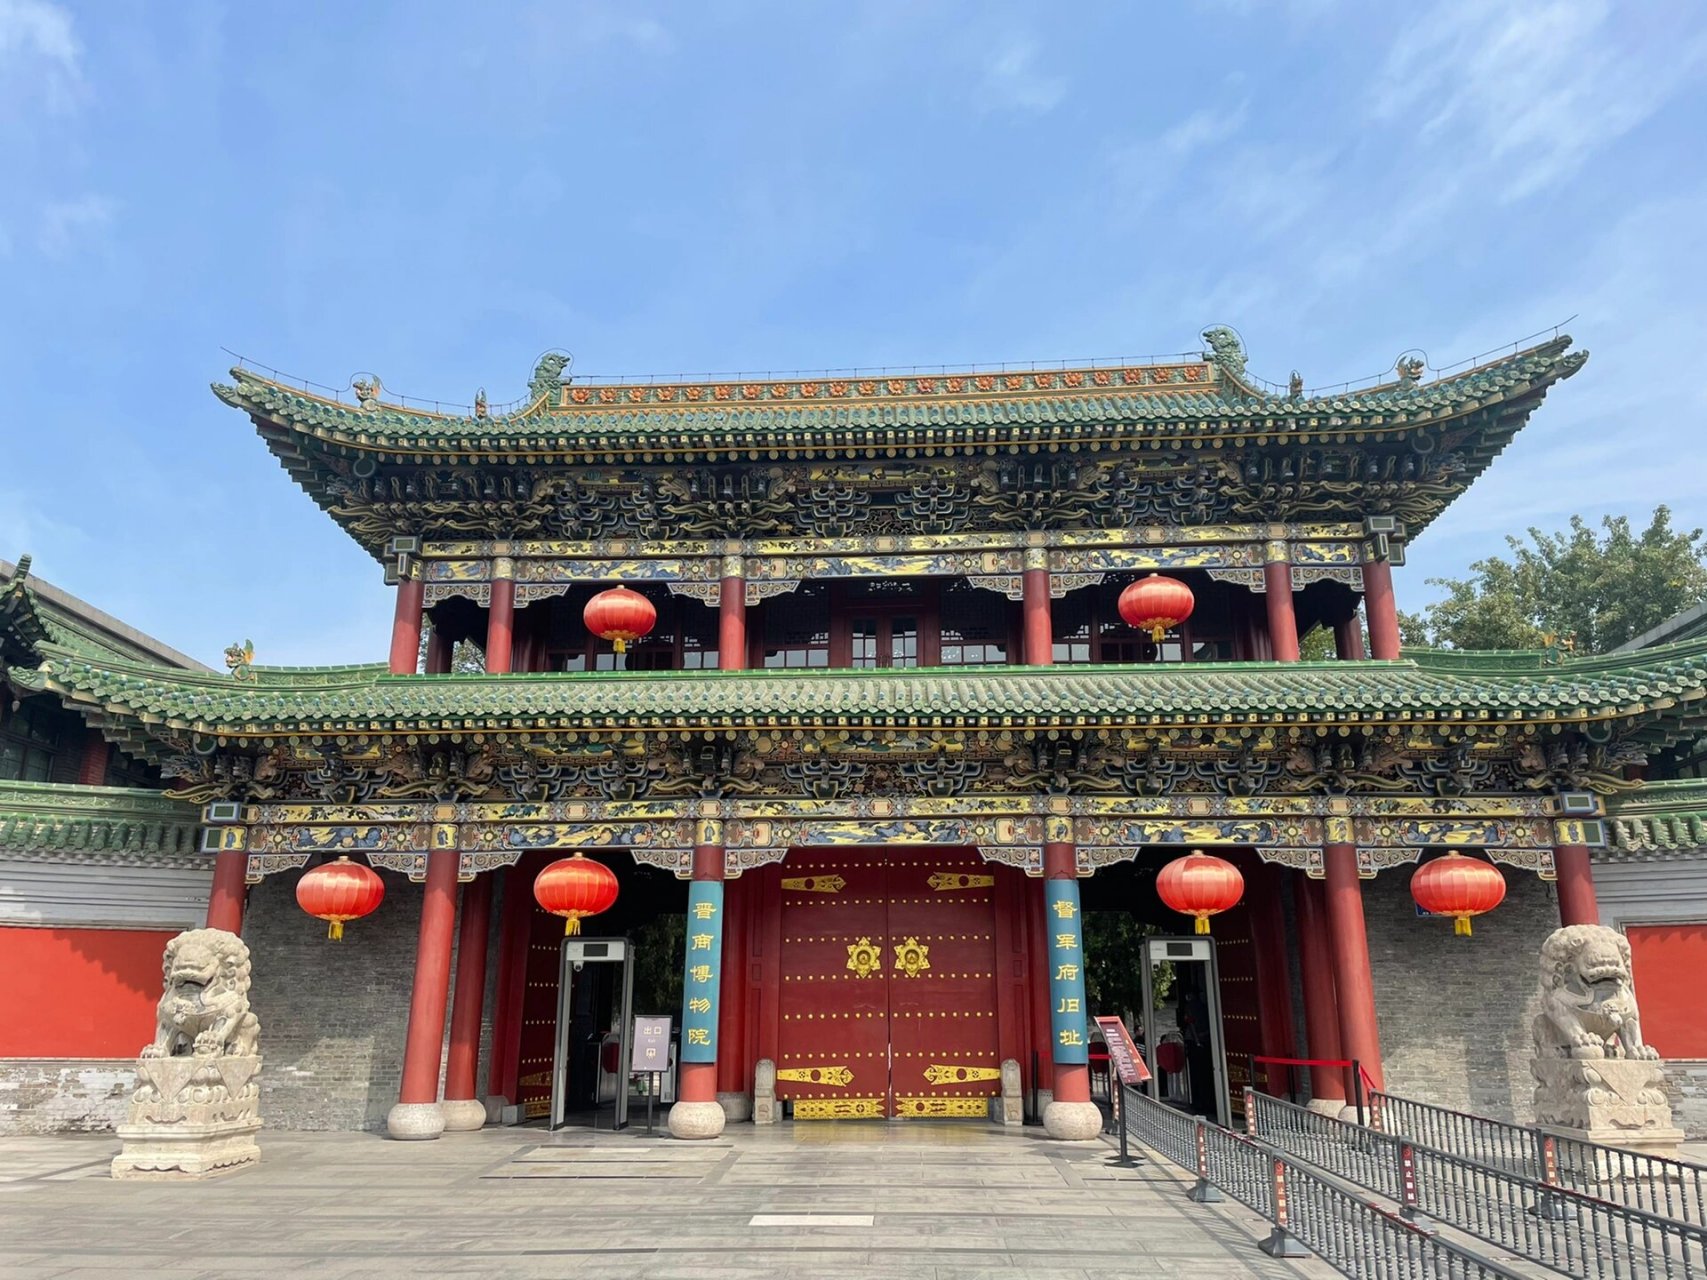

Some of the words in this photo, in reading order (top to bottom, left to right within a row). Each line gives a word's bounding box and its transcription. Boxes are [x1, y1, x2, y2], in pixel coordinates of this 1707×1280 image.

[643, 1025, 662, 1035] 出口
[688, 902, 717, 1046] 晋商博物院
[1052, 900, 1083, 1046] 督军府旧址
